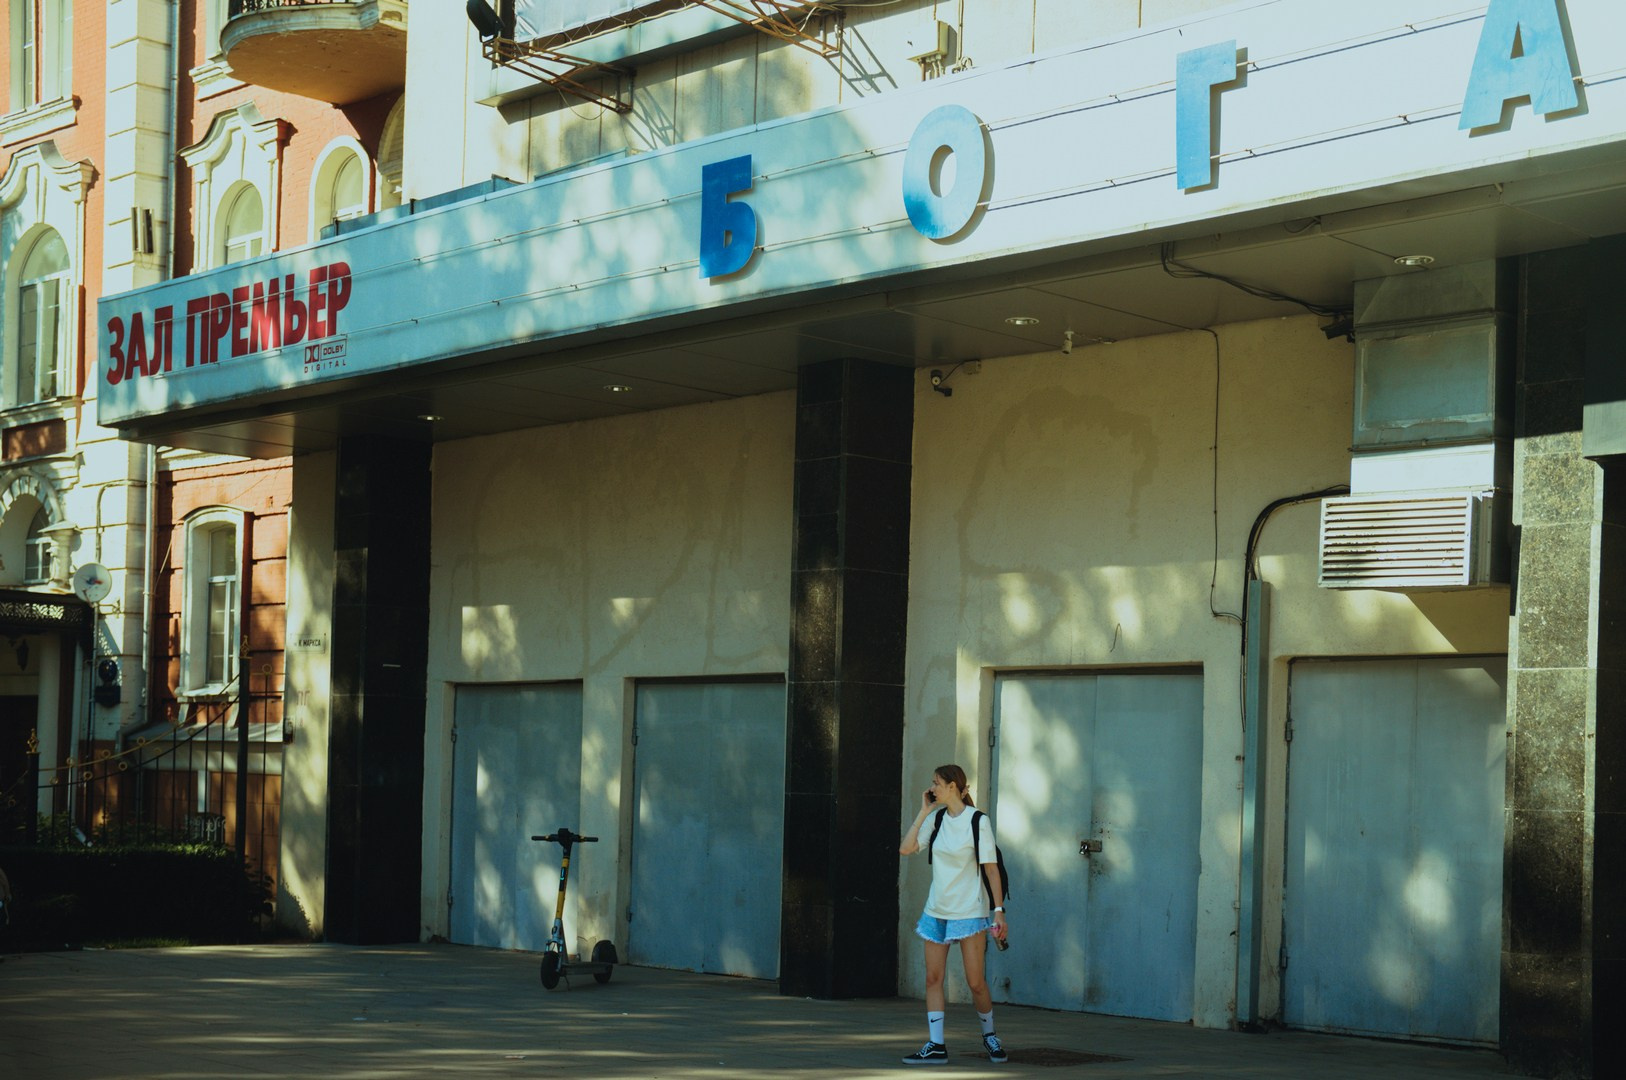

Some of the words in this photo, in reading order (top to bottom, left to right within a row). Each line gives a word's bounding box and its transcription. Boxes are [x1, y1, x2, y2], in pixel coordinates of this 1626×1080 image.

[106, 305, 173, 386] ЗАЛ
[186, 261, 352, 367] ПРЕМЬЕР
[323, 344, 344, 356] DOLBY
[304, 359, 347, 374] DIGITAL
